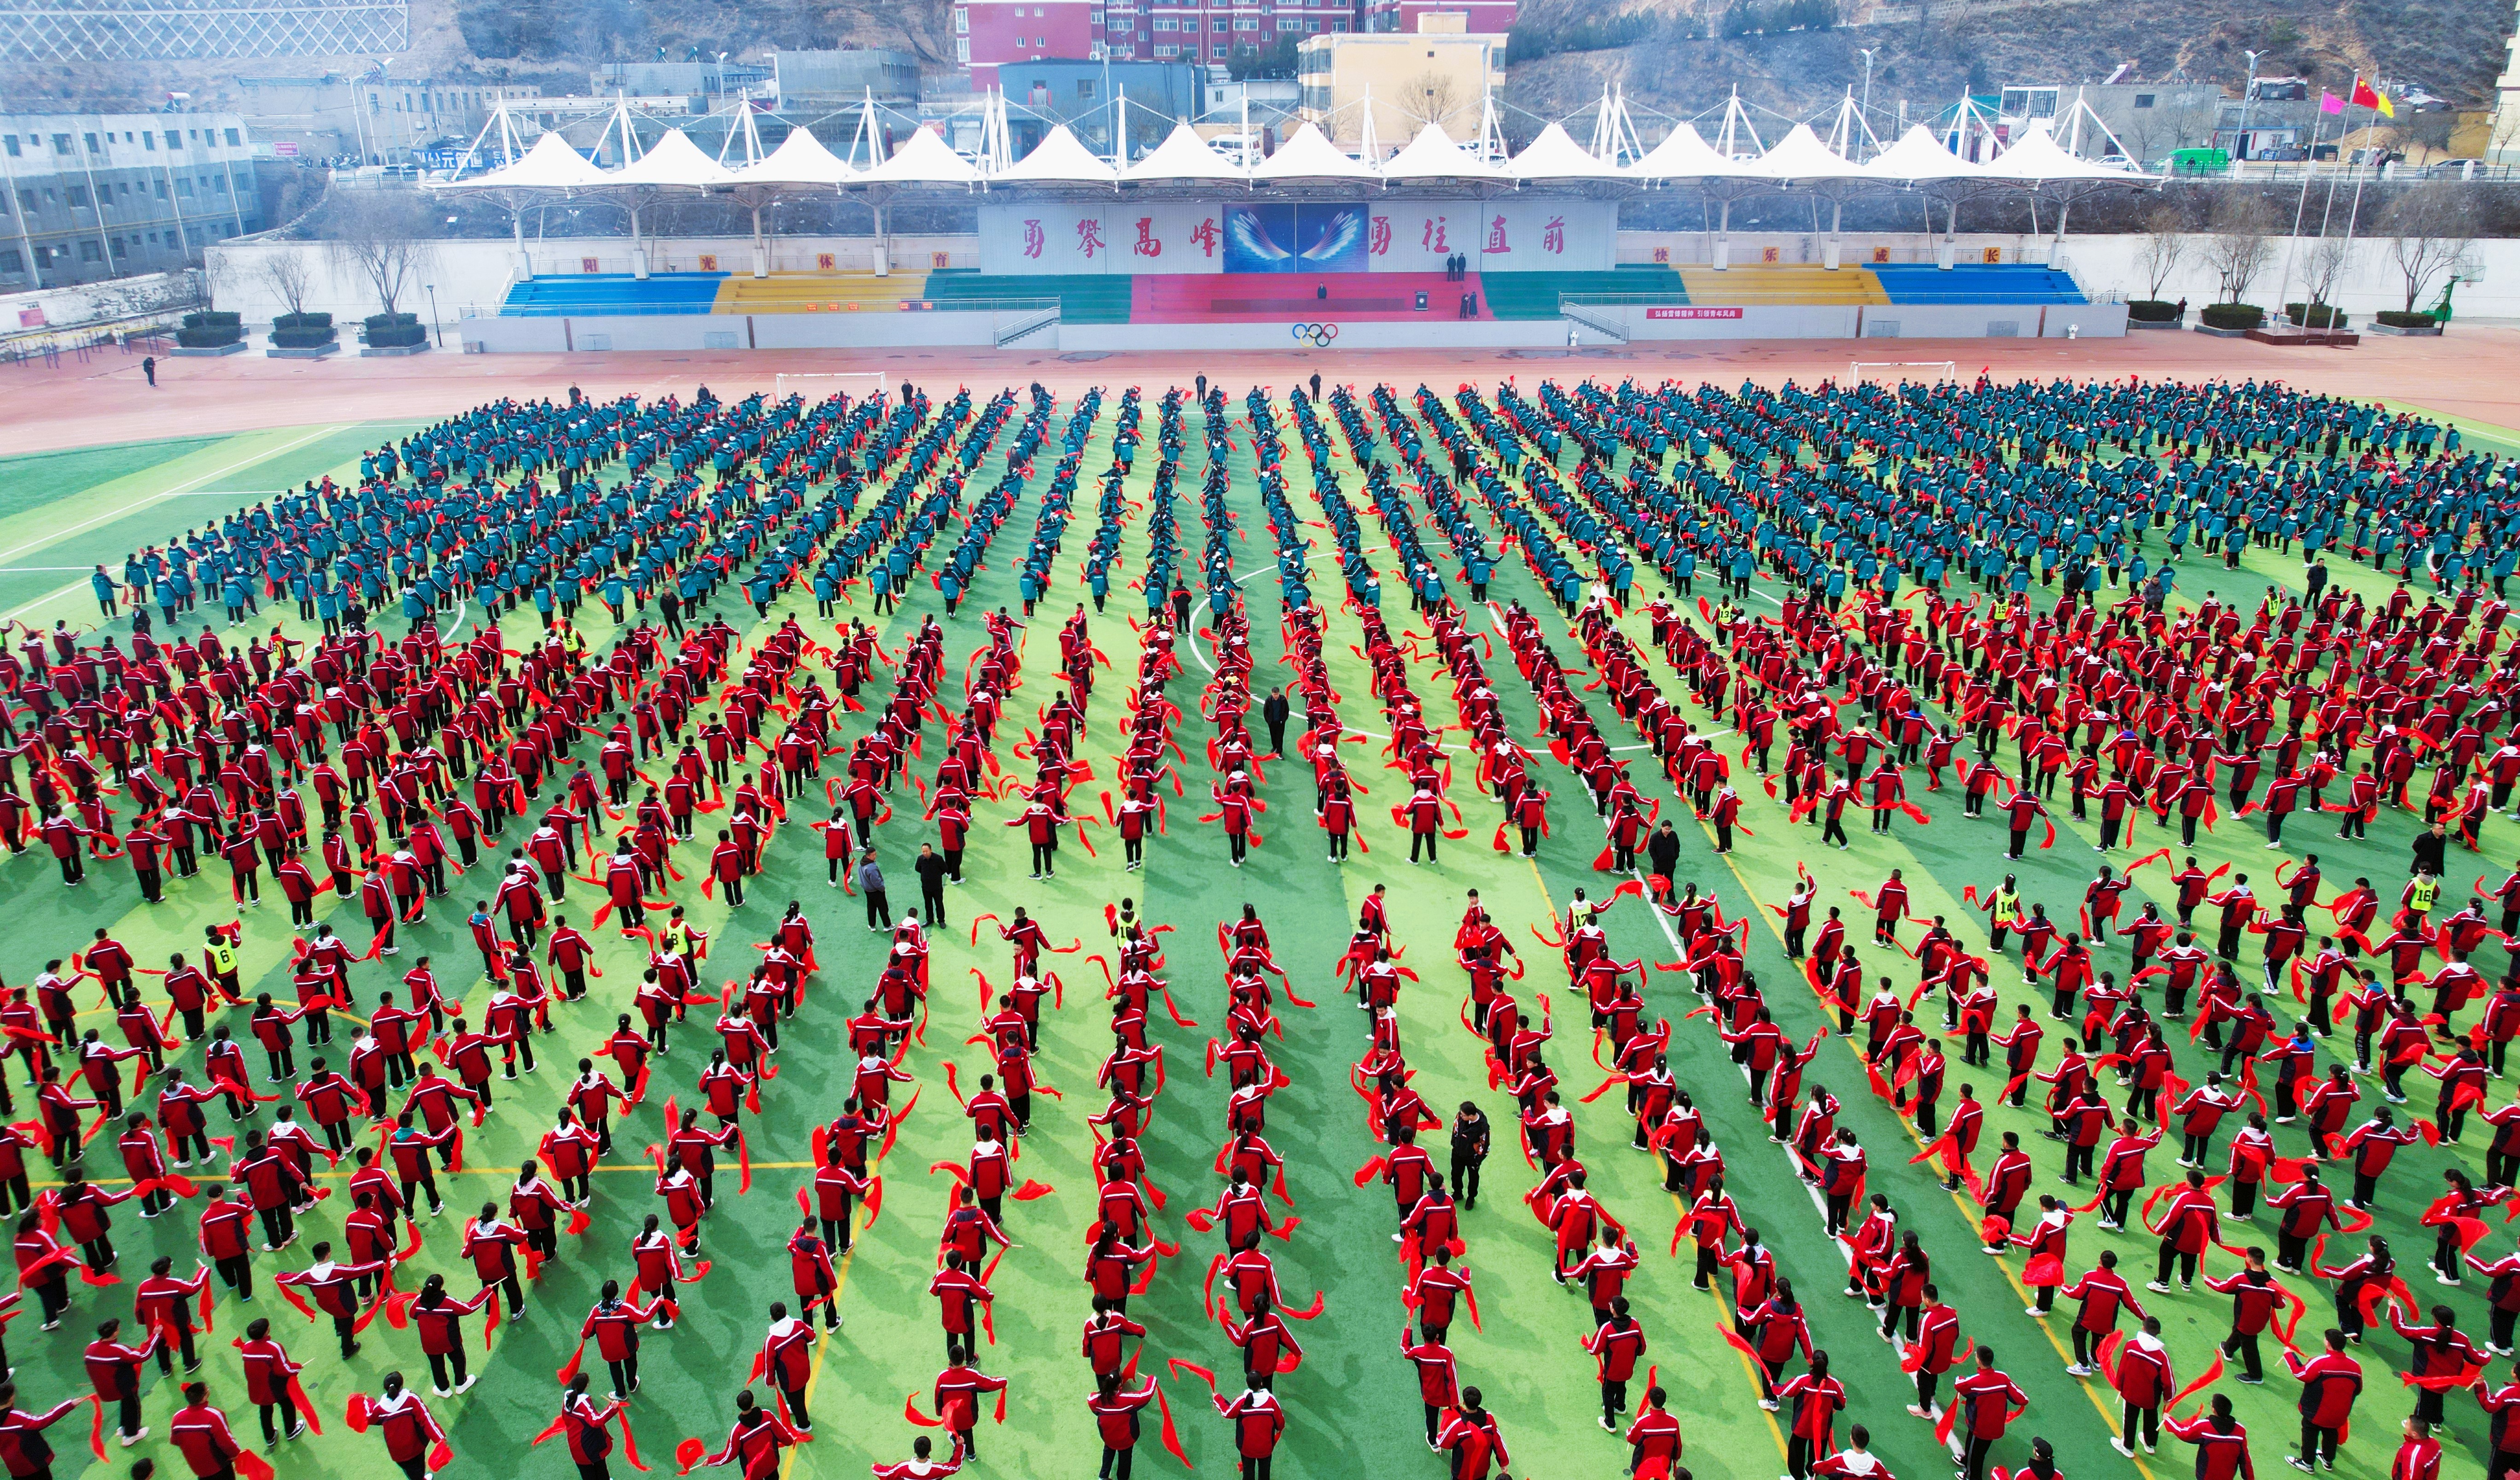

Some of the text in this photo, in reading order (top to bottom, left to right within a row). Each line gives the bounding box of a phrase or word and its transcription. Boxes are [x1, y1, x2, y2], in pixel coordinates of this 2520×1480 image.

[1024, 215, 1565, 258] 勇攀高峰 勇往直前
[2271, 600, 2278, 610] 17
[2417, 890, 2431, 902] 16
[2001, 901, 2013, 914] 14
[671, 933, 678, 945] 8
[220, 949, 230, 964] 6
